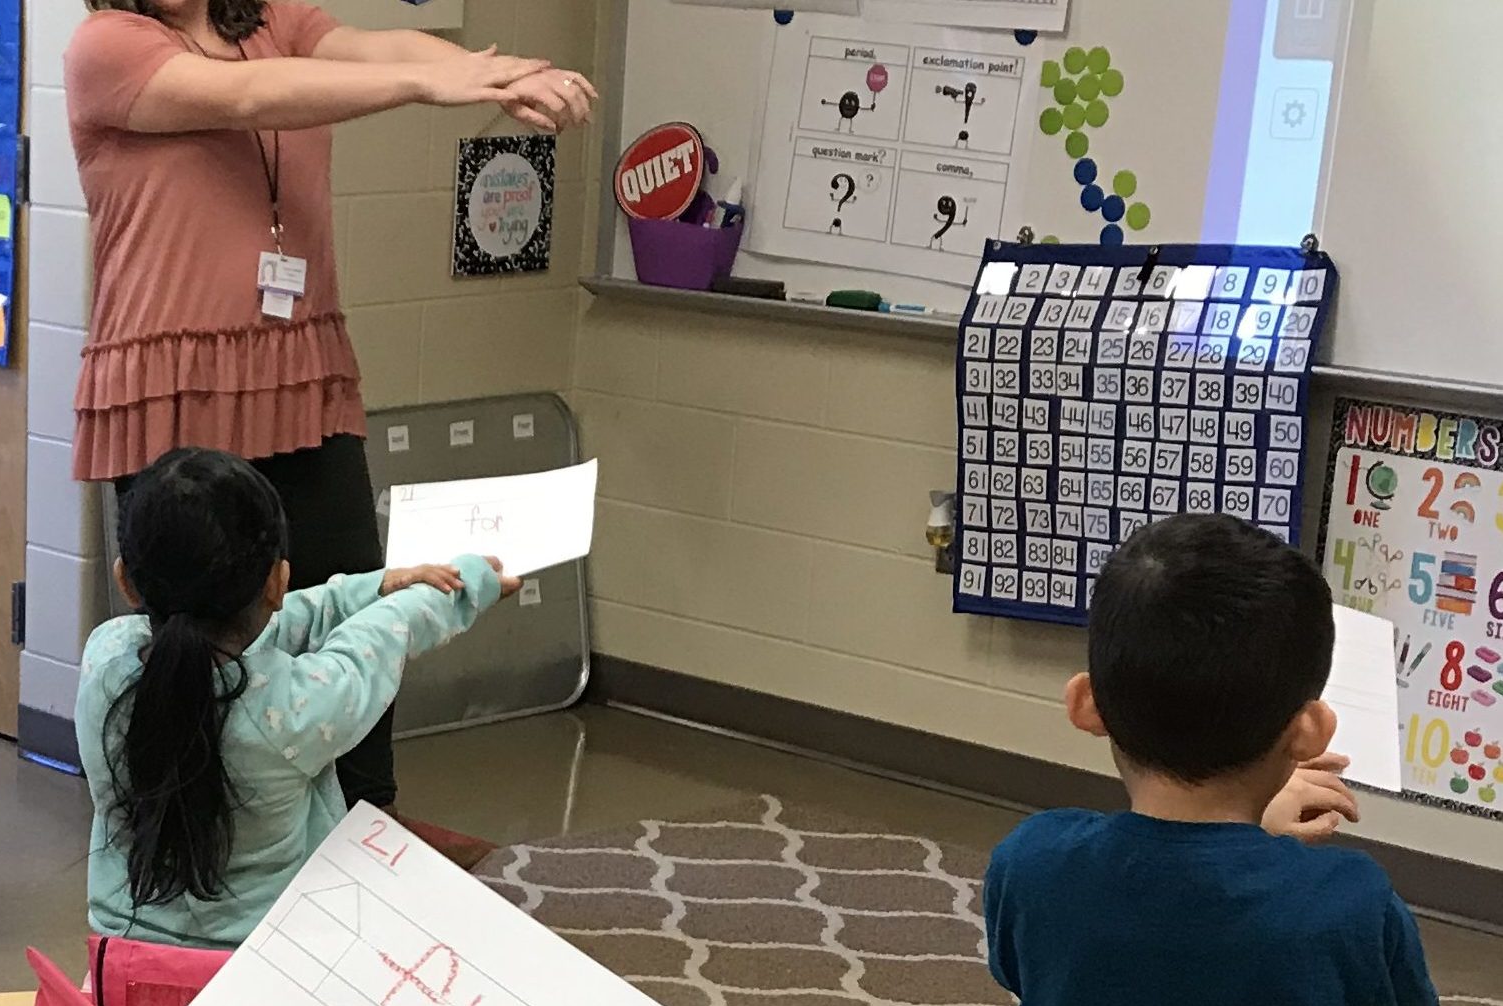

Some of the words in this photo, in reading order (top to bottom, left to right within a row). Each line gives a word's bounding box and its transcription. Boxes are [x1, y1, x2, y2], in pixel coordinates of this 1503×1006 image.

[923, 54, 985, 72] exclamation
[988, 58, 1019, 75] point!
[812, 146, 852, 161] question
[855, 149, 887, 164] mark?
[936, 162, 974, 177] comma,
[621, 138, 694, 204] QUIET
[1026, 271, 1040, 288] 2
[1056, 271, 1070, 288] 3
[1087, 273, 1101, 290] 4
[1123, 272, 1137, 290] 5
[1153, 271, 1167, 289] 6
[1223, 274, 1237, 292] 8
[1263, 274, 1277, 294] 9
[1299, 276, 1318, 295] 10
[981, 301, 997, 318] 11
[1007, 303, 1027, 320] 12
[1043, 305, 1063, 322] 13
[1071, 306, 1091, 322] 14
[1110, 307, 1130, 325] 15
[1143, 307, 1161, 326] 16
[1211, 310, 1230, 329] 18
[1257, 312, 1271, 330] 9
[1284, 312, 1311, 332] 20
[968, 334, 986, 353] 21
[997, 336, 1019, 355] 22
[1033, 337, 1054, 356] 23
[1065, 338, 1087, 357] 24
[1101, 338, 1123, 358] 25
[1131, 340, 1154, 360] 26
[1167, 342, 1193, 362] 27
[1198, 344, 1223, 364] 28
[1239, 345, 1265, 366] 29
[1280, 346, 1306, 366] 30
[969, 368, 987, 388] 31
[996, 370, 1016, 389] 32
[1032, 369, 1053, 389] 33
[1059, 371, 1079, 389] 34
[1097, 374, 1118, 394] 35
[1127, 376, 1149, 396] 36
[1163, 378, 1186, 398] 37
[1198, 380, 1221, 401] 38
[1235, 383, 1259, 404] 39
[1269, 383, 1295, 405] 40
[967, 402, 985, 421] 41
[995, 402, 1016, 423] 42
[1025, 405, 1046, 426] 43
[1062, 406, 1084, 427] 44
[1091, 410, 1113, 430] 45
[1129, 413, 1152, 432] 46
[1162, 415, 1185, 435] 47
[1193, 417, 1215, 438] 48
[1227, 420, 1252, 441] 49
[1275, 422, 1299, 444] 50
[1345, 405, 1500, 466] NUMBERS
[967, 436, 983, 455] 51
[997, 438, 1015, 457] 52
[1029, 440, 1050, 459] 53
[1061, 443, 1083, 462] 54
[1091, 444, 1111, 464] 55
[1124, 447, 1147, 468] 56
[1157, 449, 1179, 470] 57
[1190, 452, 1213, 473] 58
[1227, 456, 1253, 476] 59
[1270, 458, 1294, 479] 60
[969, 470, 985, 489] 61
[993, 472, 1013, 492] 62
[1023, 475, 1043, 494] 63
[1060, 478, 1082, 498] 64
[1091, 480, 1112, 500] 65
[1120, 482, 1142, 502] 66
[1153, 486, 1176, 506] 67
[1189, 490, 1211, 510] 68
[1225, 491, 1249, 512] 69
[1263, 495, 1288, 516] 70
[1346, 455, 1361, 505] 1
[1417, 467, 1444, 519] 2
[464, 505, 504, 535] for
[967, 503, 983, 522] 71
[994, 506, 1015, 525] 72
[1029, 509, 1049, 528] 73
[1057, 512, 1079, 531] 74
[1087, 514, 1107, 534] 75
[1353, 509, 1381, 528] ONE
[1428, 521, 1459, 541] TWO
[968, 537, 985, 556] 81
[994, 540, 1014, 558] 82
[1029, 543, 1048, 563] 83
[1053, 544, 1074, 564] 84
[1333, 538, 1356, 591] 4
[964, 570, 981, 590] 91
[995, 574, 1015, 594] 92
[1025, 578, 1045, 598] 93
[1053, 581, 1073, 601] 94
[1408, 552, 1436, 604] 5
[1422, 608, 1456, 630] FIVE
[1486, 620, 1503, 640] SI
[1440, 640, 1465, 691] 8
[1427, 690, 1470, 713] EIGHT
[1404, 713, 1451, 768] 10
[1411, 766, 1438, 785] TEN
[359, 819, 407, 868] 21
